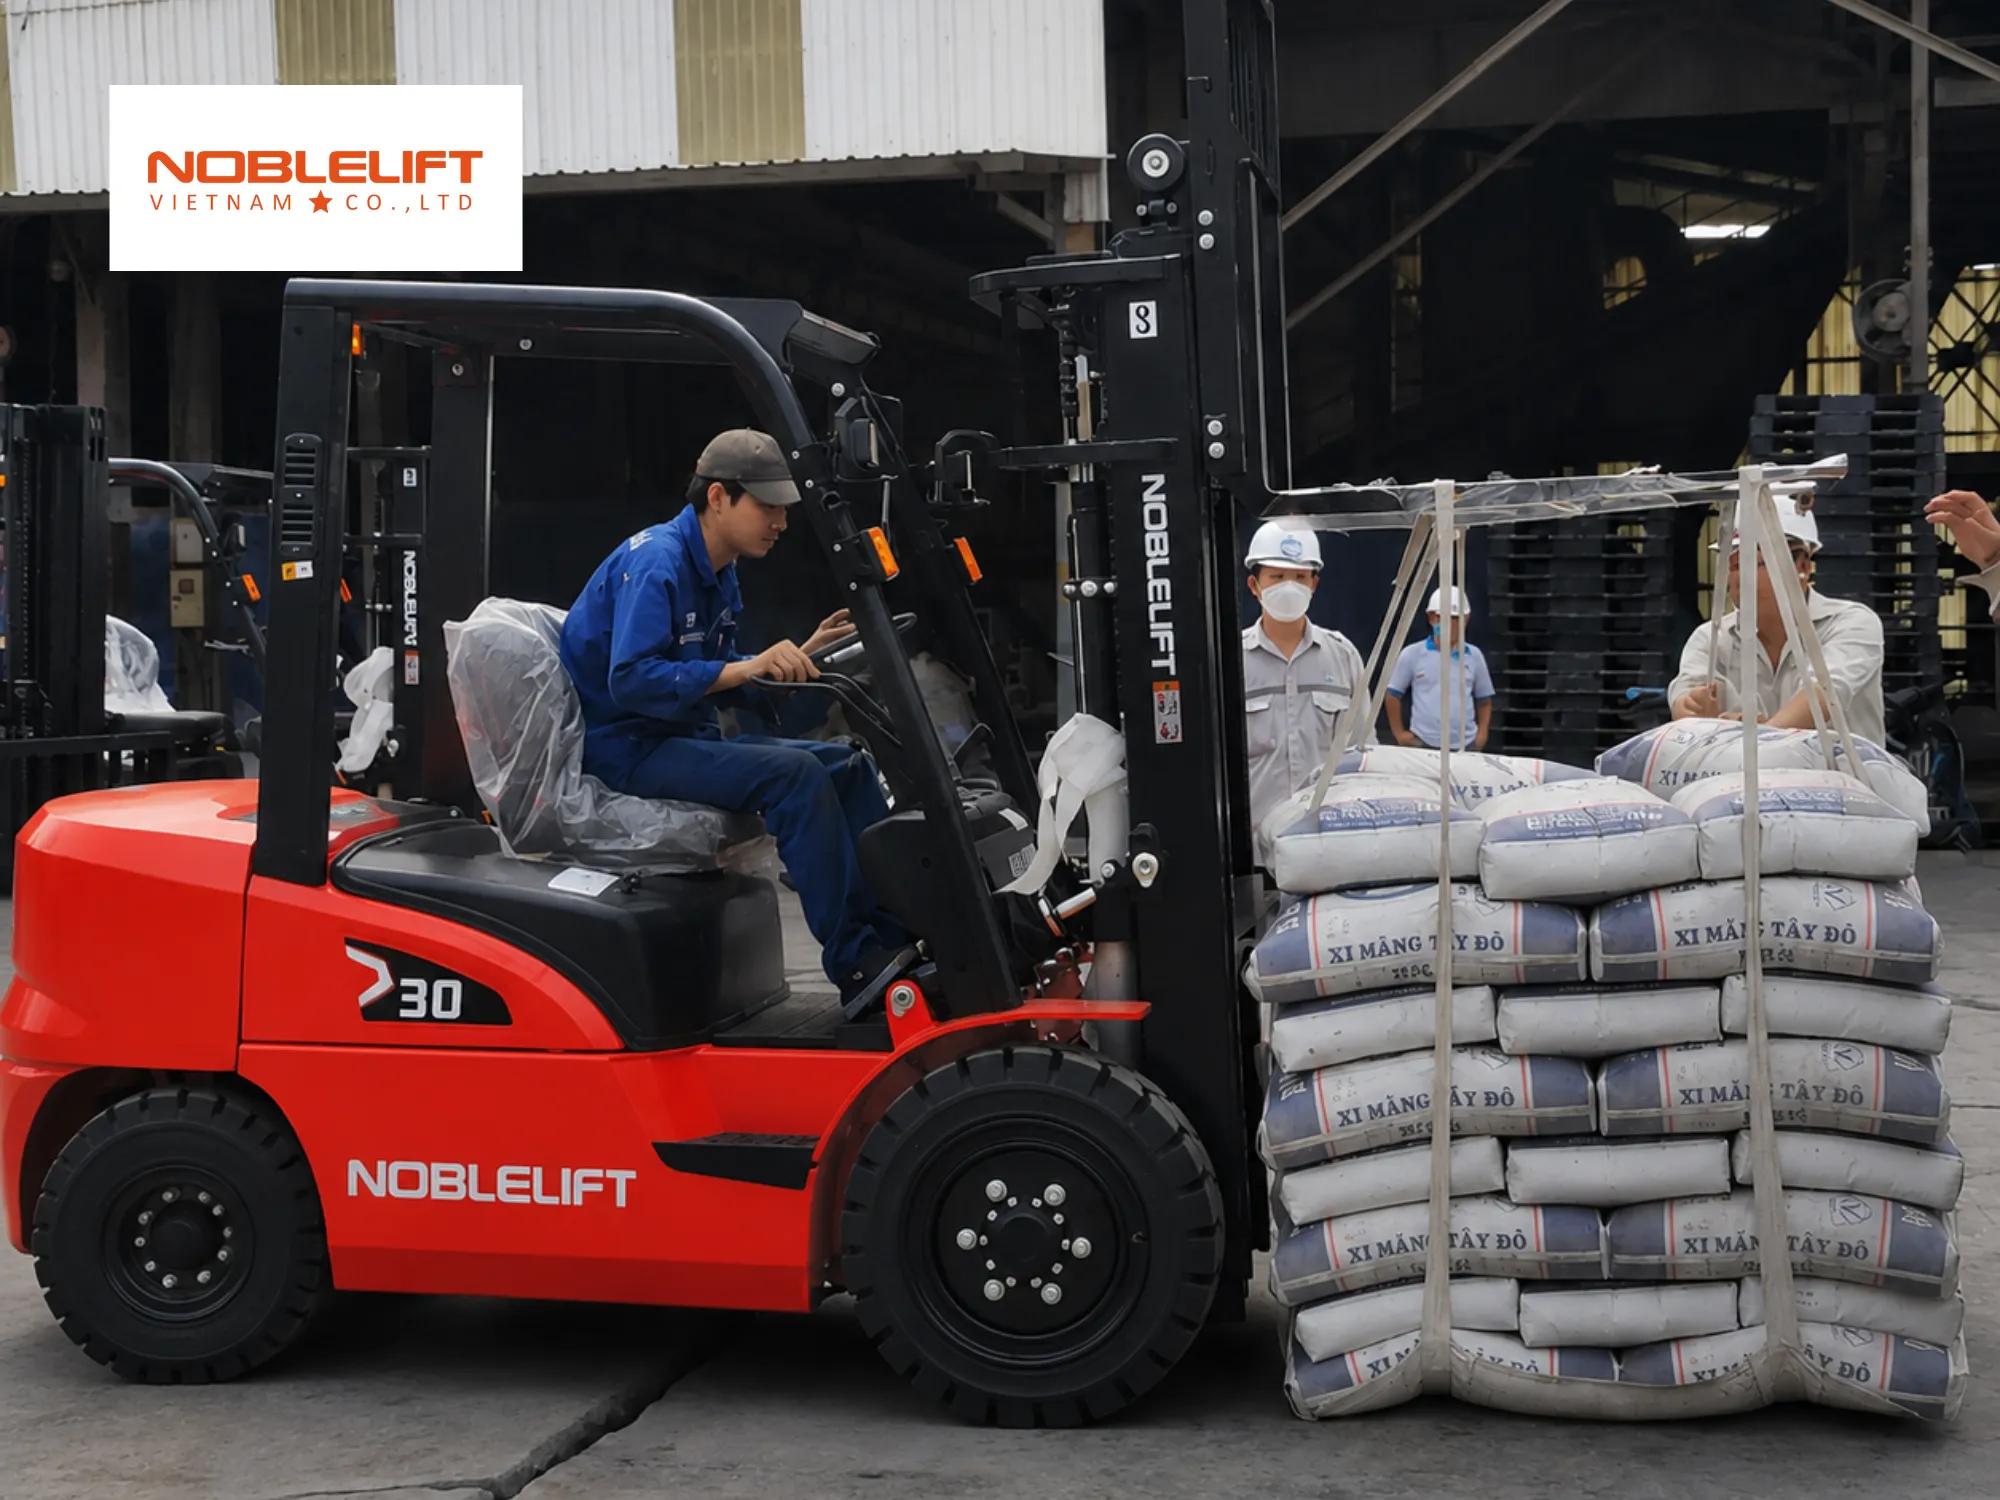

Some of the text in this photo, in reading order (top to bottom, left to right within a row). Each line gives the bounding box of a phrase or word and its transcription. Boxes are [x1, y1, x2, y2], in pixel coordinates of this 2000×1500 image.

[1141, 473, 1176, 676] NOBLELIFT
[1675, 928, 1700, 947] XI
[1771, 917, 1818, 941] TÂY
[1328, 944, 1353, 964] XI
[399, 977, 463, 1020] 30
[1337, 1106, 1363, 1127] XI
[1367, 1093, 1430, 1121] MĂNG
[1484, 1086, 1515, 1107] ĐÔ
[1679, 1088, 1703, 1105] XI
[1780, 1078, 1826, 1101] TÂY
[1832, 1084, 1864, 1106] ĐÔ
[347, 1159, 637, 1208] NOBLELIFT
[1347, 1244, 1373, 1264] XI
[1496, 1229, 1527, 1250] ĐÔ
[1684, 1237, 1709, 1254] XI
[1787, 1231, 1832, 1254] TÂY
[1837, 1240, 1869, 1261] ĐÔ
[1366, 1356, 1392, 1379] XI
[1837, 1361, 1871, 1383] ĐÔ
